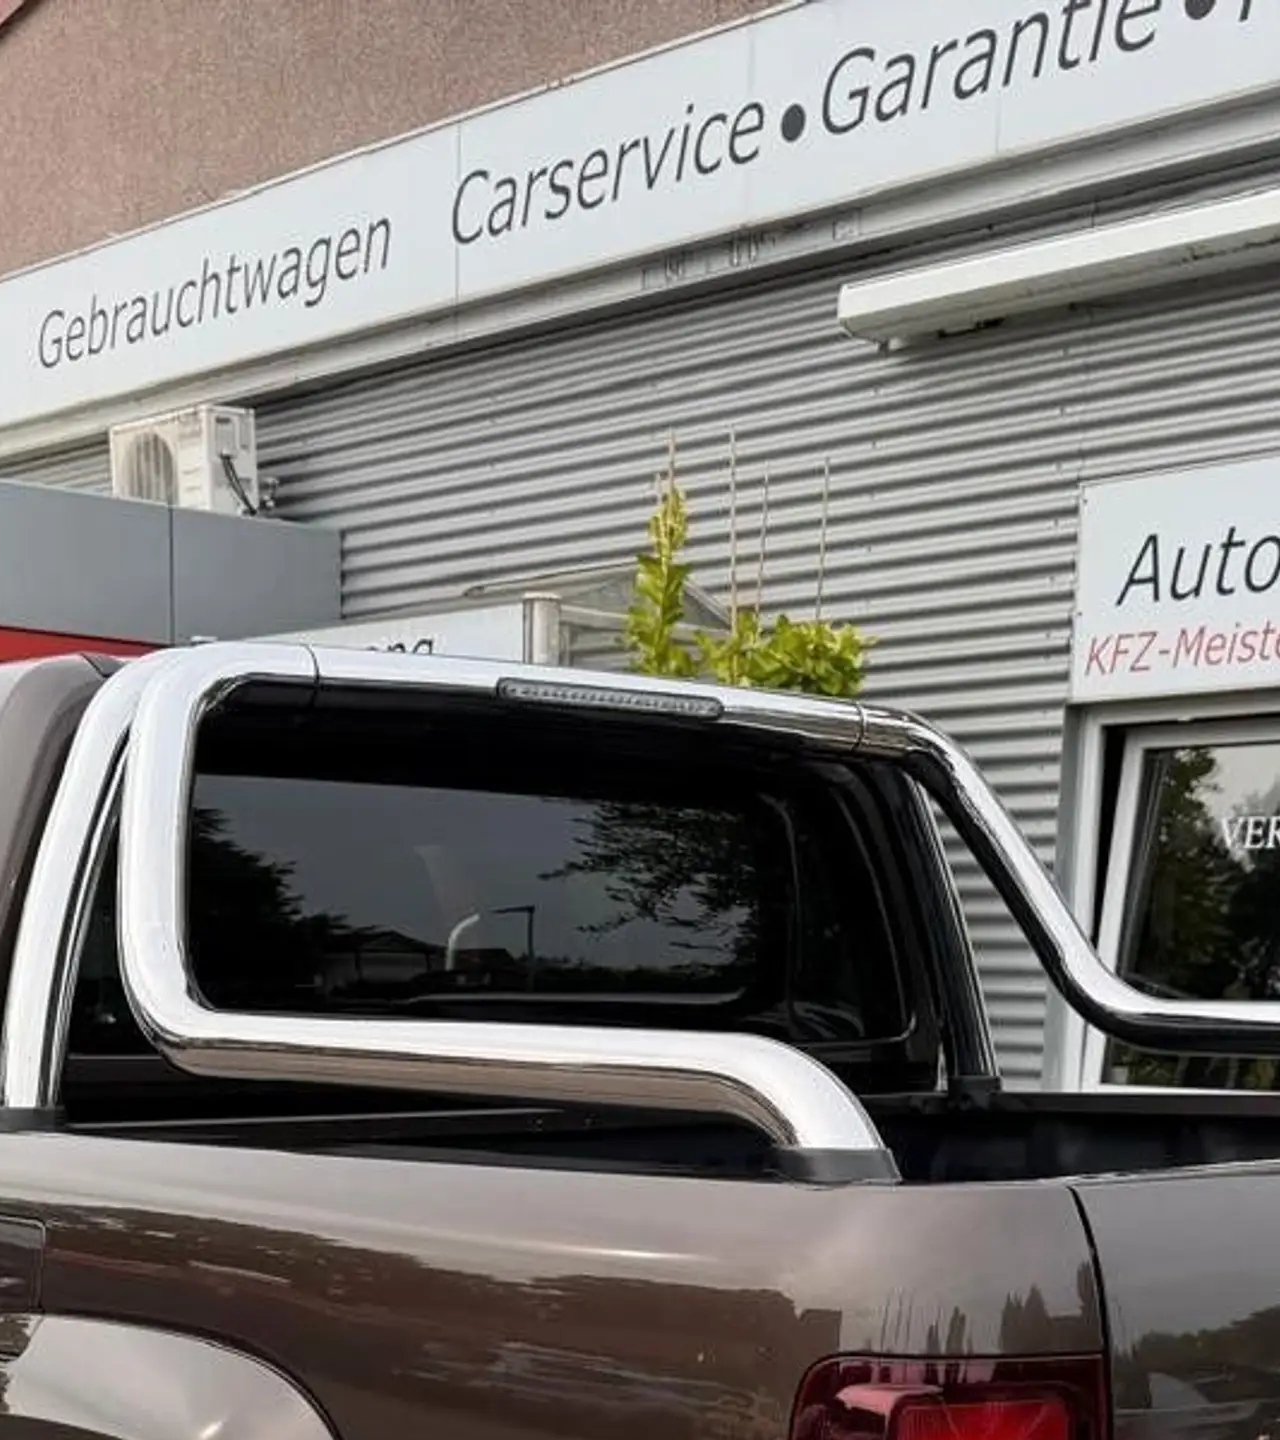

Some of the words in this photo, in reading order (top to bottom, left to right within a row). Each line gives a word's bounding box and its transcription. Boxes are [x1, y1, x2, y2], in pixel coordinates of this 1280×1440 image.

[452, 102, 765, 246] Carservice
[821, 0, 1162, 137] Garantie
[39, 216, 392, 370] Gebrauchtwagen
